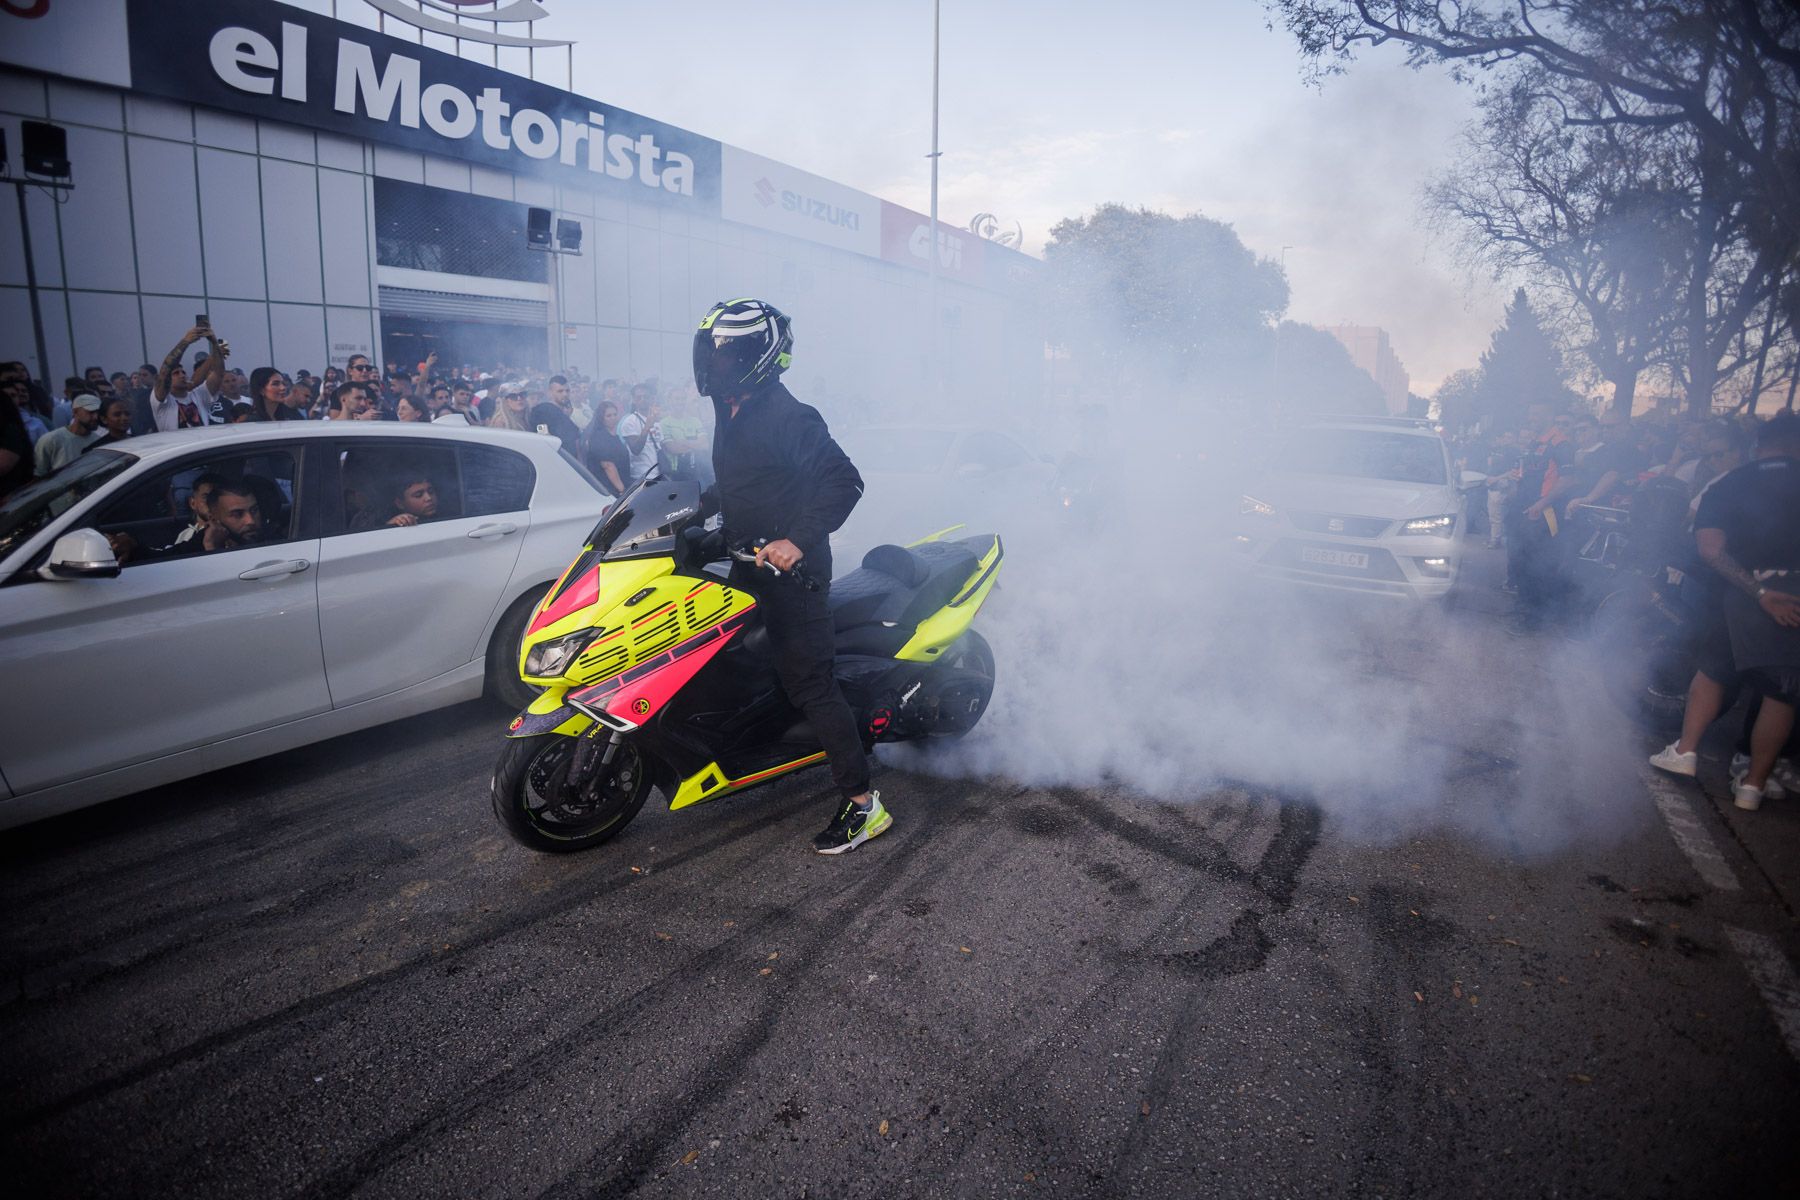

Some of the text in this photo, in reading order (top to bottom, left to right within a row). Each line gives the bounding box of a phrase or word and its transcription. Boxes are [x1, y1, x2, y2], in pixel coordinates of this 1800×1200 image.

[209, 21, 695, 197] el Motorista
[781, 192, 859, 231] SUZUKI
[909, 225, 961, 271] GVI
